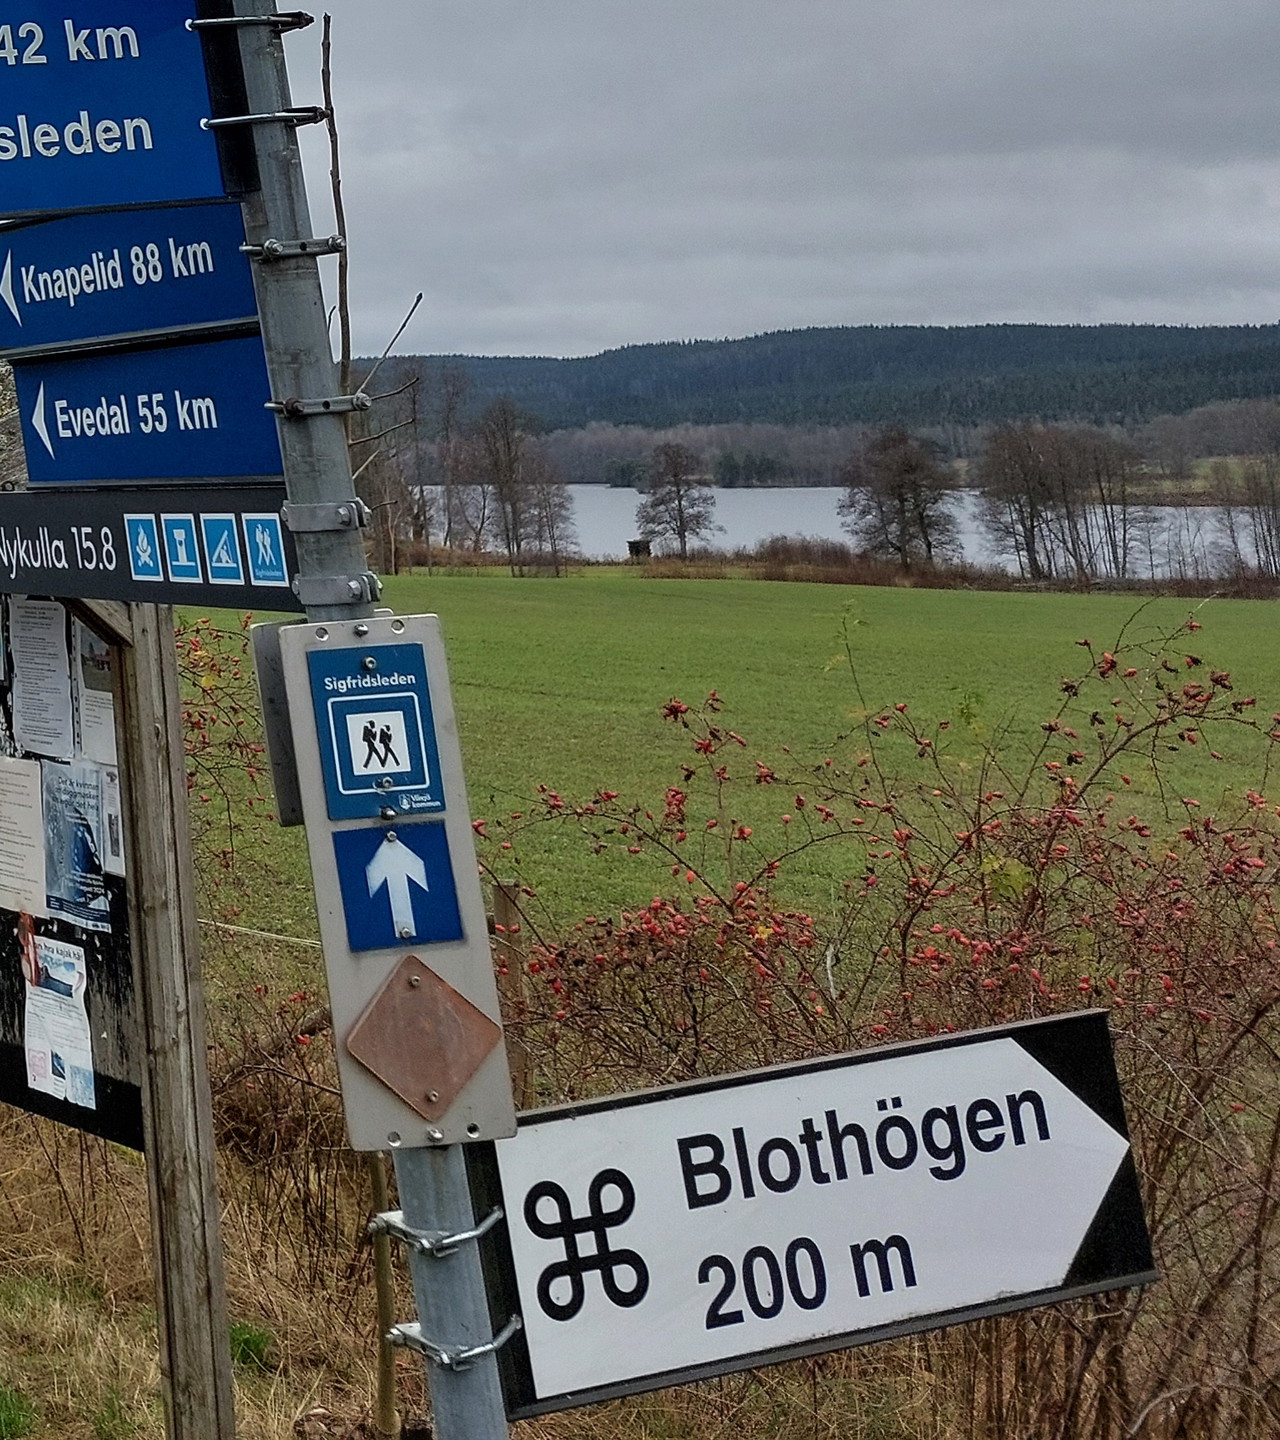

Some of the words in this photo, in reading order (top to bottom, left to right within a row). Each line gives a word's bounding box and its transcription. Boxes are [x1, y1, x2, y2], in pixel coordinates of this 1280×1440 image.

[65, 18, 140, 63] km
[20, 247, 124, 308] Knapelid
[130, 242, 163, 286] 88
[168, 237, 215, 279] km
[54, 394, 131, 439] Evedal
[137, 392, 168, 434] 55
[174, 390, 218, 431] km
[71, 525, 117, 572] 15.8
[324, 672, 417, 693] Sigfridsleden
[676, 1088, 1053, 1210] Blothögen
[696, 1235, 827, 1331] 200
[849, 1232, 918, 1299] m
